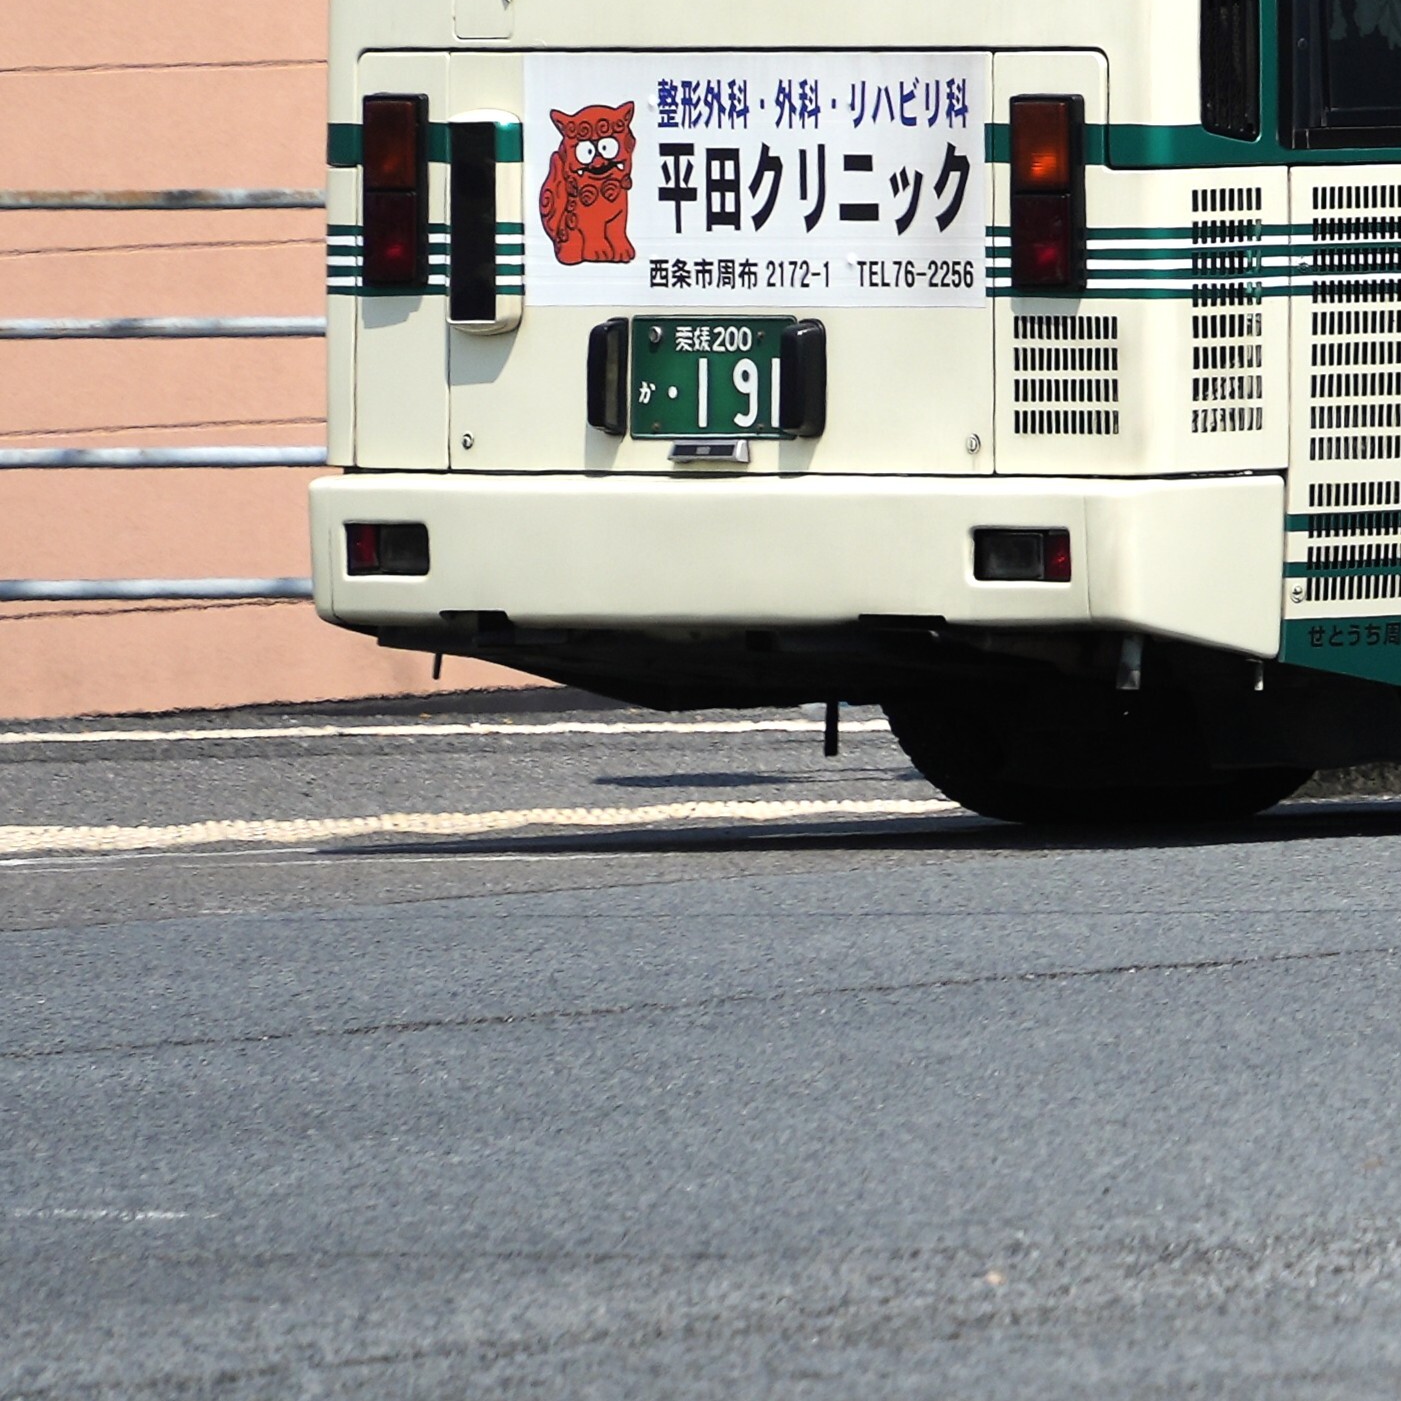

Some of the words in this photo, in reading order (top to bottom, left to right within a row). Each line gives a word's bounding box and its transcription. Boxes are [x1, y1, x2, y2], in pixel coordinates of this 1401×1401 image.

[656, 77, 969, 129] 整形外科・外科・リハビリ科
[657, 141, 971, 236] 平田クリニック
[649, 258, 759, 289] 西条市周布
[765, 261, 831, 288] 2172-1
[857, 259, 975, 289] TEL76-2256
[638, 381, 656, 404] か
